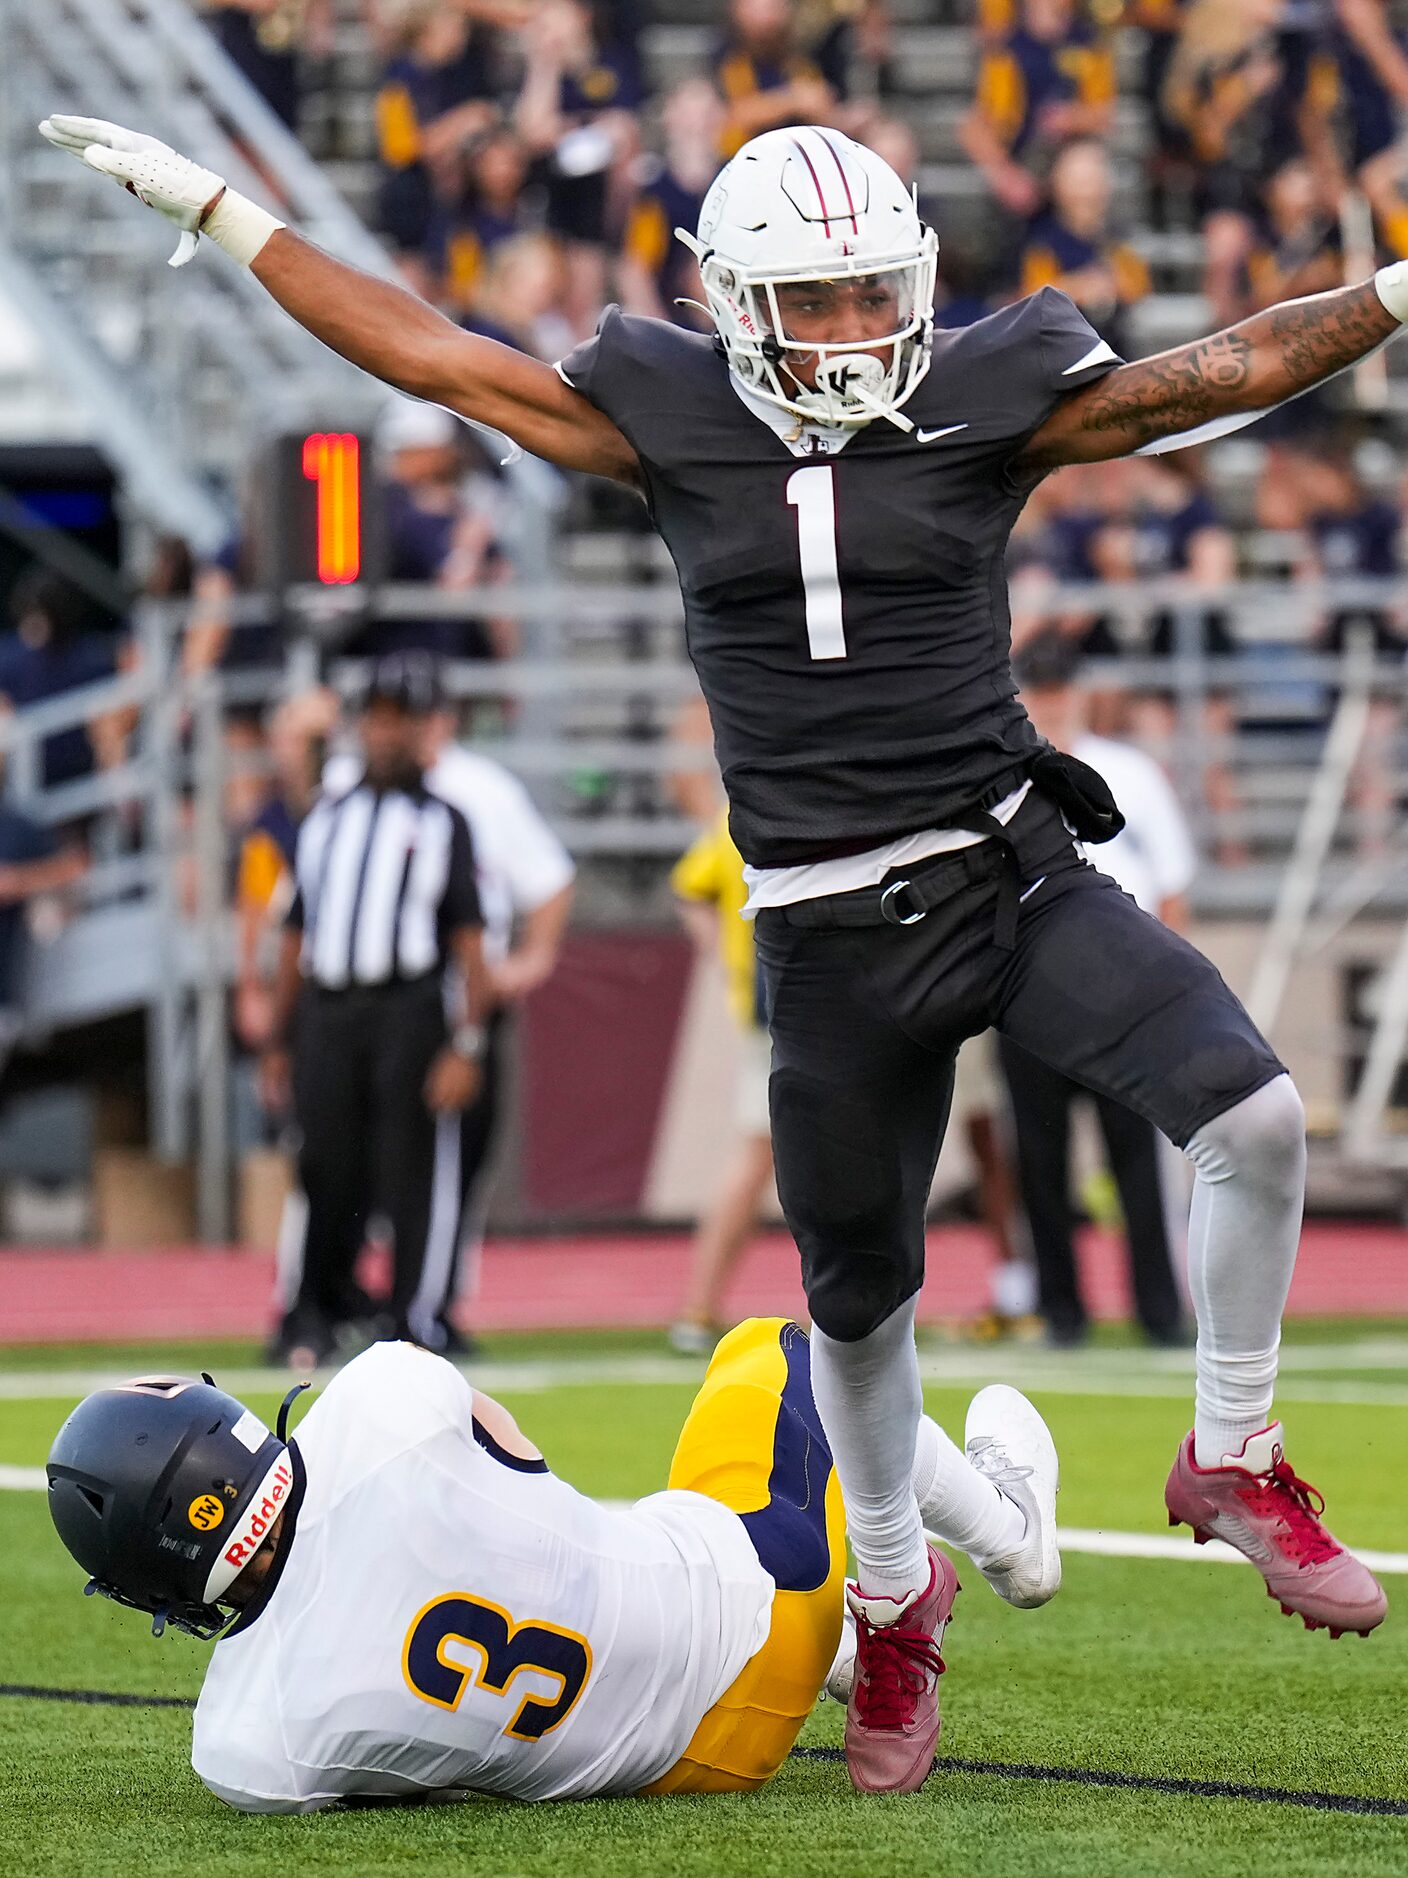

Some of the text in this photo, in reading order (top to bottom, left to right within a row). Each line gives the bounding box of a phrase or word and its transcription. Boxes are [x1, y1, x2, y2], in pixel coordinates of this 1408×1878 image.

[302, 433, 361, 585] 1
[784, 463, 849, 662] 1
[193, 1496, 221, 1529] JW
[224, 1465, 293, 1568] Riddell
[401, 1591, 594, 1744] 3
